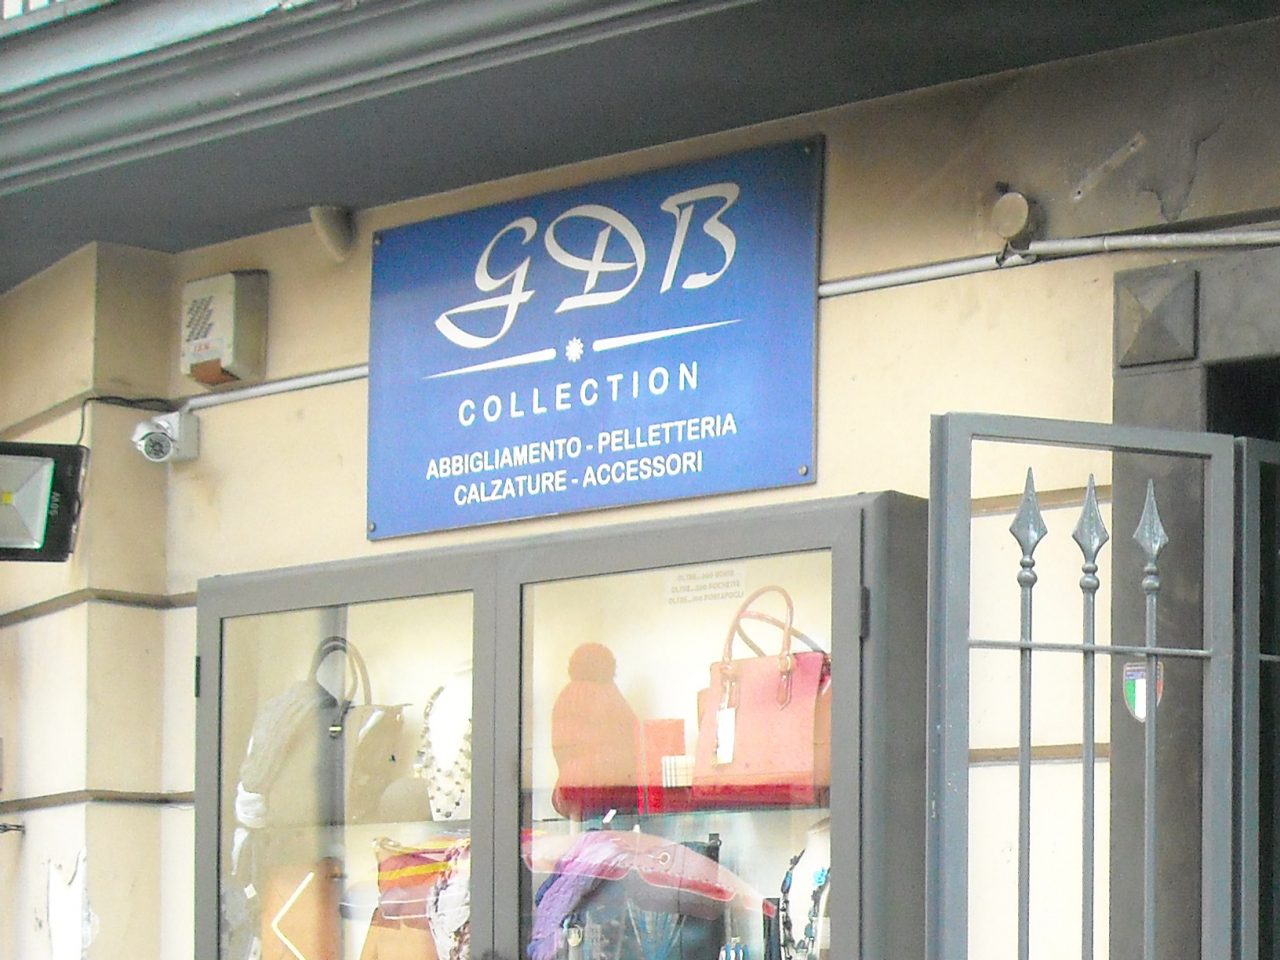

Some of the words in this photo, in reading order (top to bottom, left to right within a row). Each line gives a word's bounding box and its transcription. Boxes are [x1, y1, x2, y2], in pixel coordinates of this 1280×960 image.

[434, 182, 740, 349] GDB
[457, 360, 699, 427] COLLECTION
[425, 436, 582, 481] ABBIGLIAMENTO
[597, 411, 738, 454] PELLETTERIA
[453, 469, 567, 506] CALZATURE
[582, 449, 703, 488] ACCESSORI
